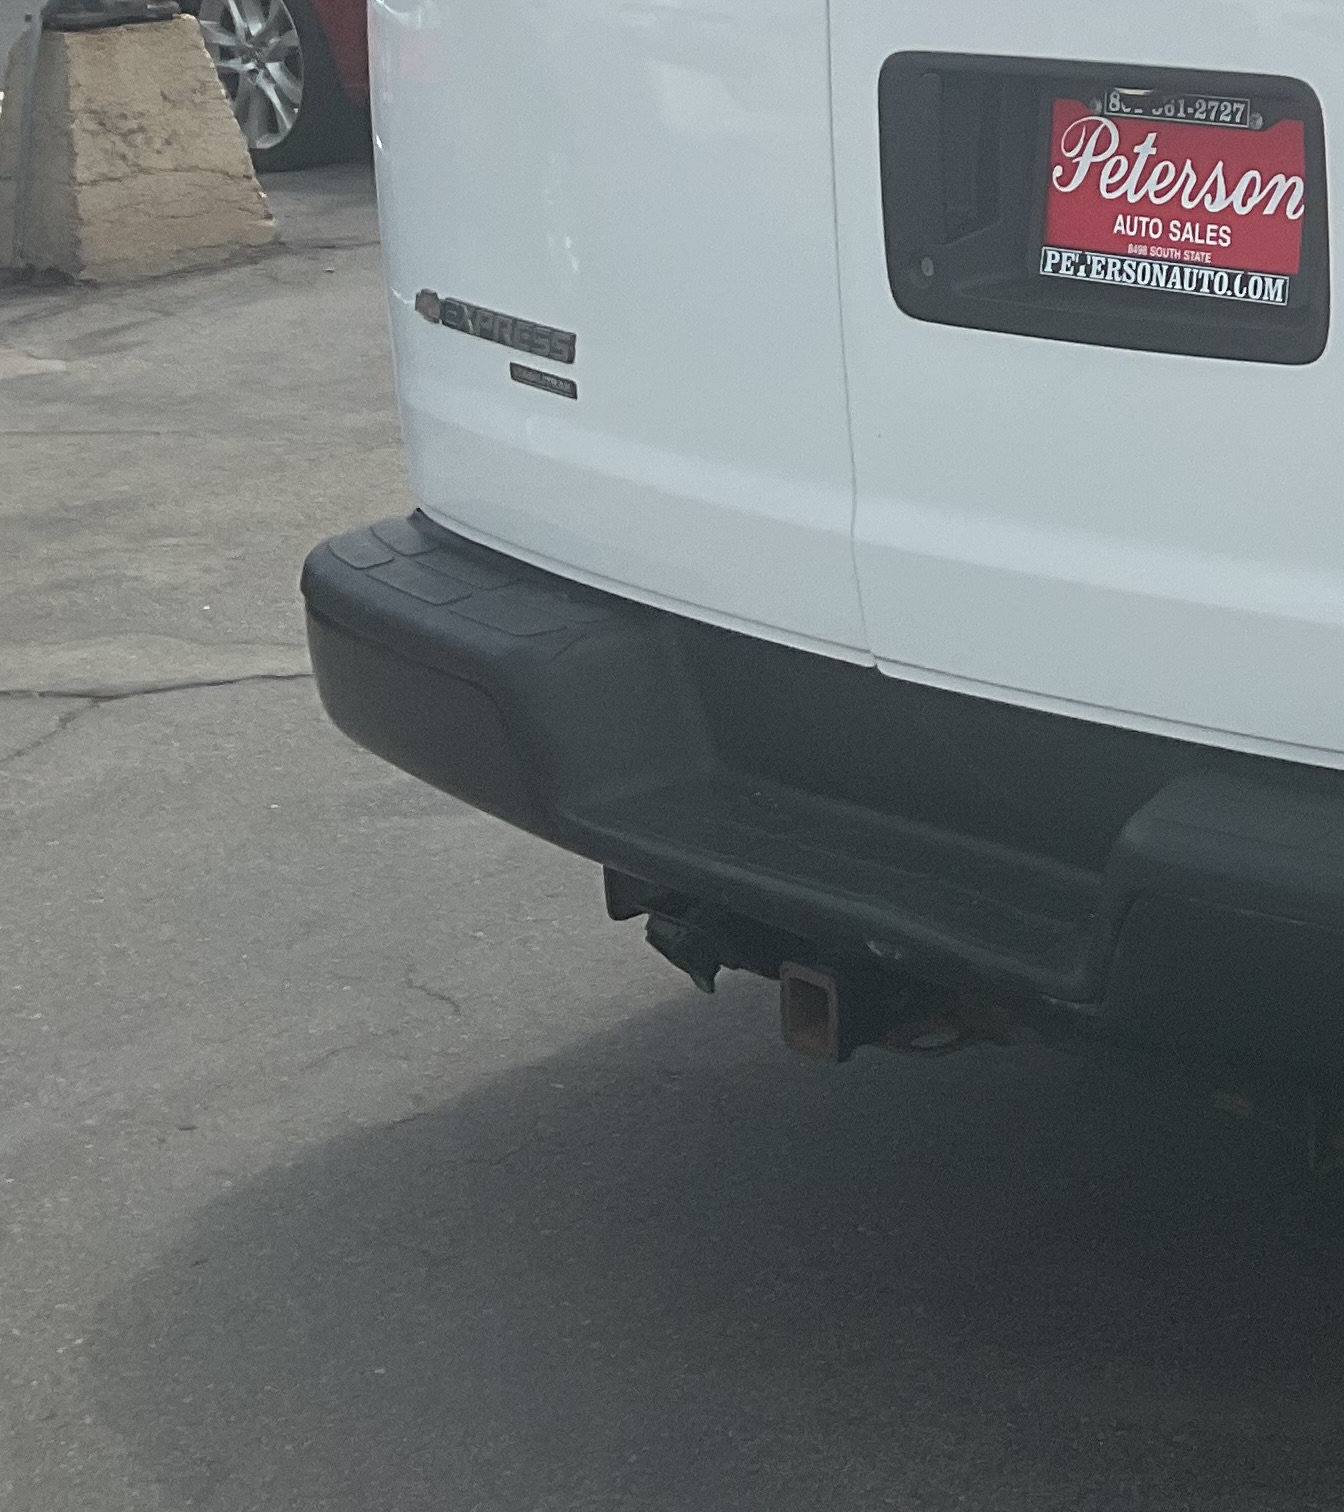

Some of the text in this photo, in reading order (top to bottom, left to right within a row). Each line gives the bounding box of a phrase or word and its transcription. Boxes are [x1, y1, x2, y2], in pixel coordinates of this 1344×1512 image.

[1052, 115, 1305, 220] Peterson
[1113, 214, 1231, 247] AUTO SALES
[1149, 246, 1181, 260] SOUTH
[1183, 250, 1212, 264] STATE
